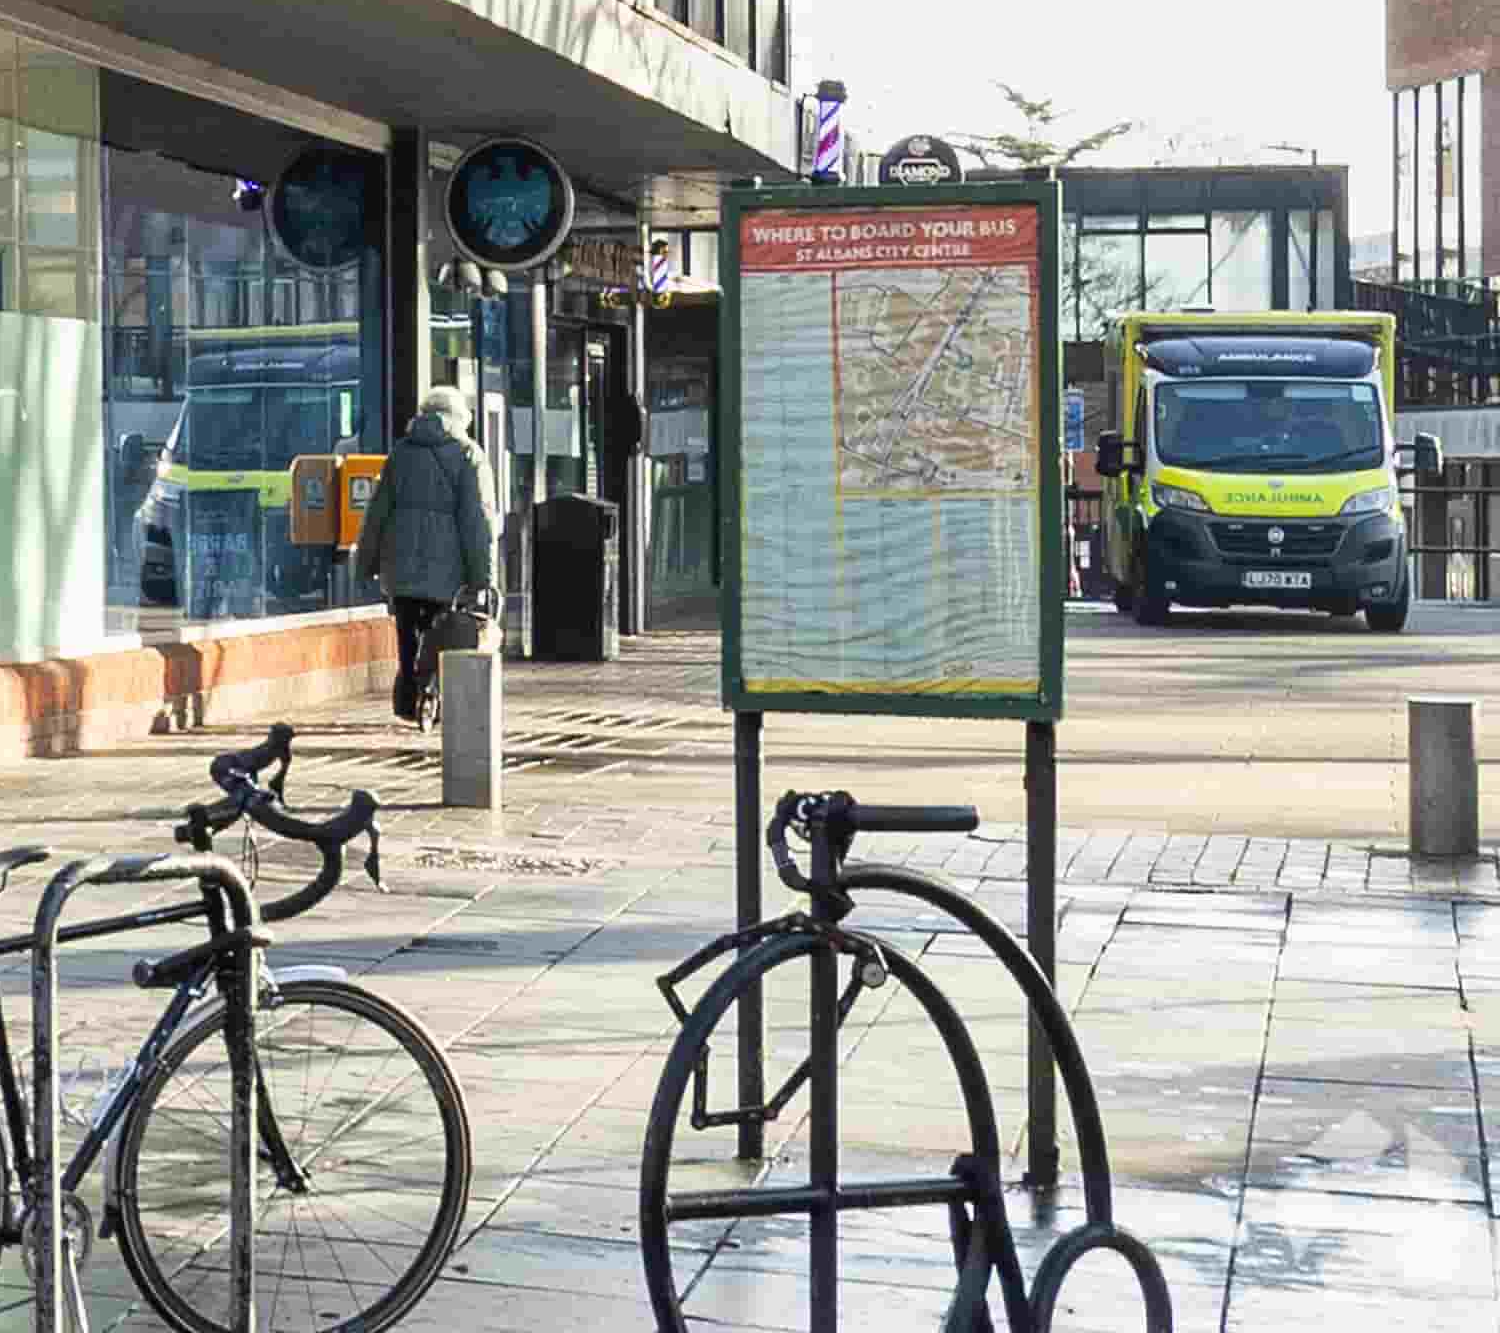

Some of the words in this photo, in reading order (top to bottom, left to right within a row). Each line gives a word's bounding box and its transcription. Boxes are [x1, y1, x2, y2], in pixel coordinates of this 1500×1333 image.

[889, 165, 952, 178] DIAMOND
[753, 226, 815, 244] WHERE
[819, 224, 846, 242] TO
[851, 222, 916, 240] BOARD
[919, 220, 975, 239] YOUR
[979, 218, 1017, 236] BUS
[796, 248, 813, 262] ST
[816, 246, 873, 261] ALBANS
[875, 245, 910, 259] CITY
[913, 244, 972, 258] CENTRE
[1216, 350, 1317, 364] AMBULANCE
